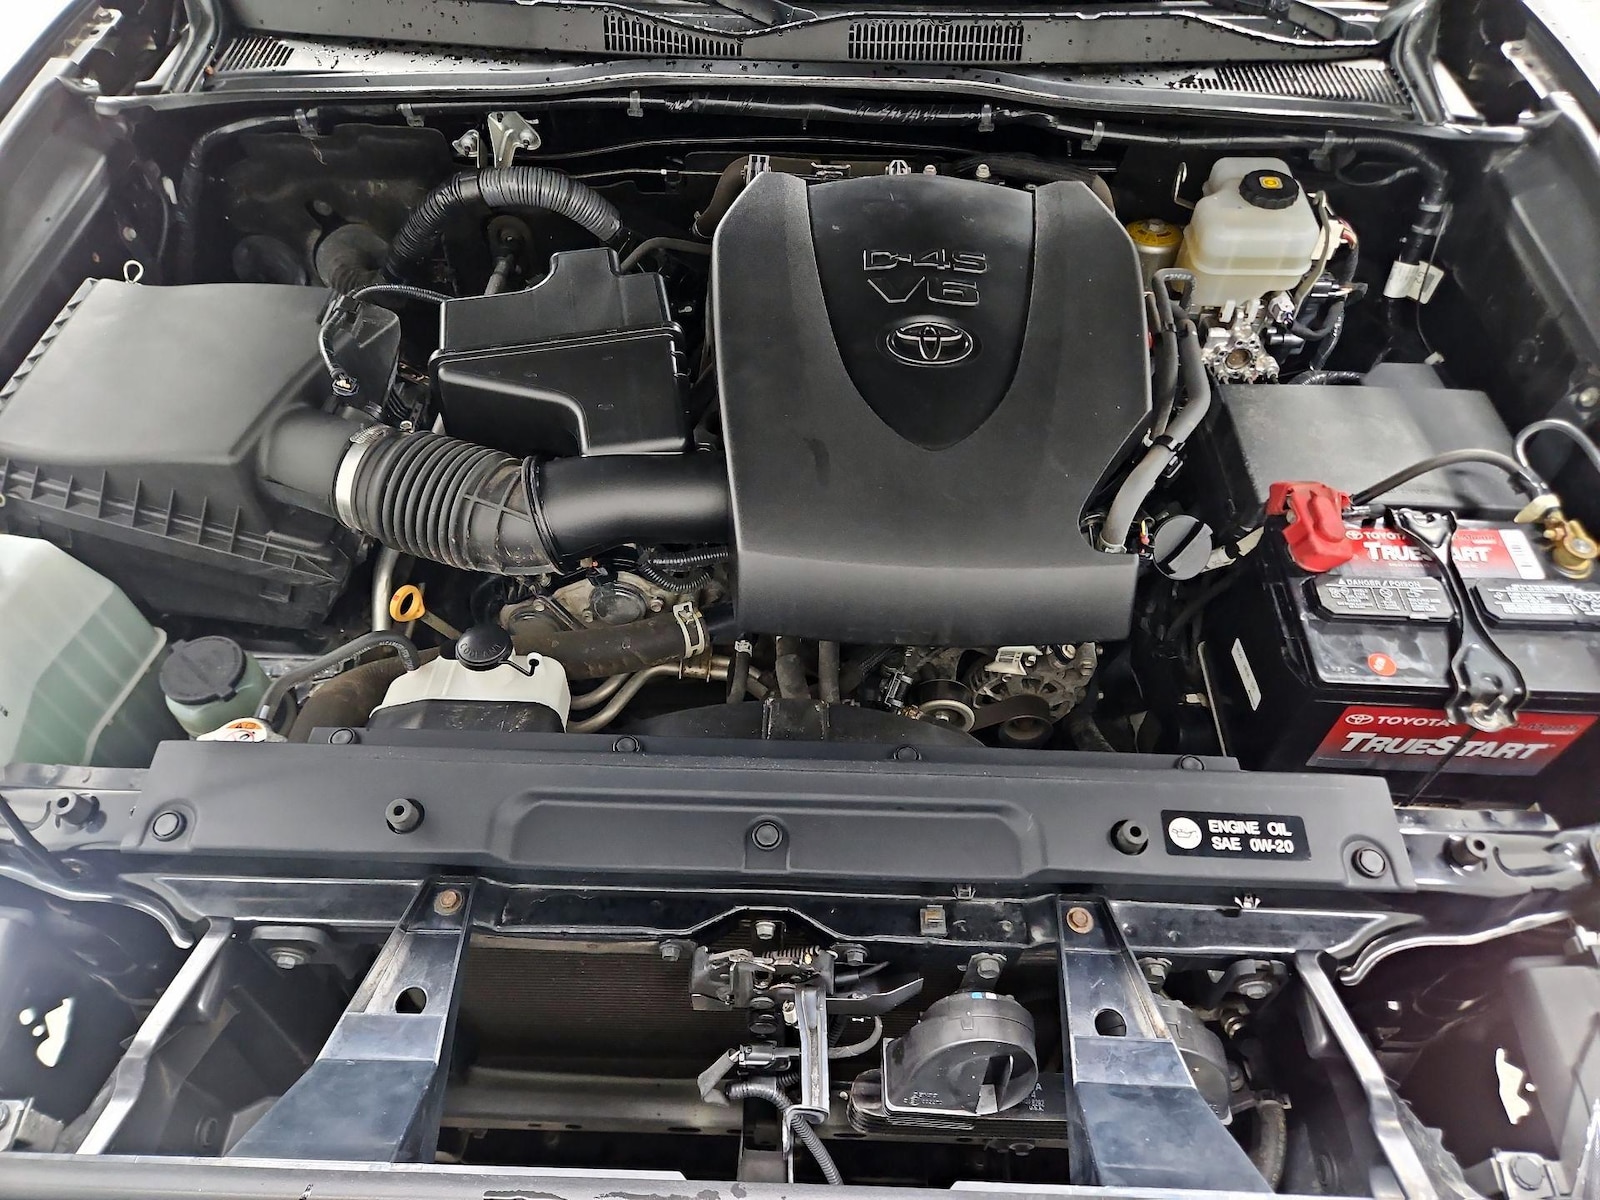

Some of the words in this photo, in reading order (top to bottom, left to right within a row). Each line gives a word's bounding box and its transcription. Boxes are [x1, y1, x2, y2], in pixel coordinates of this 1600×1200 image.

[863, 248, 988, 275] D-4S
[867, 276, 980, 307] V6
[1345, 578, 1381, 587] DANGER
[1389, 580, 1421, 589] POISON
[460, 642, 502, 659] COOLANT
[1377, 715, 1449, 728] TOYOTA
[1207, 819, 1261, 835] ENGINE
[1267, 821, 1292, 837] OIL
[1211, 836, 1242, 851] SAE
[1250, 838, 1295, 854] 0W-20
